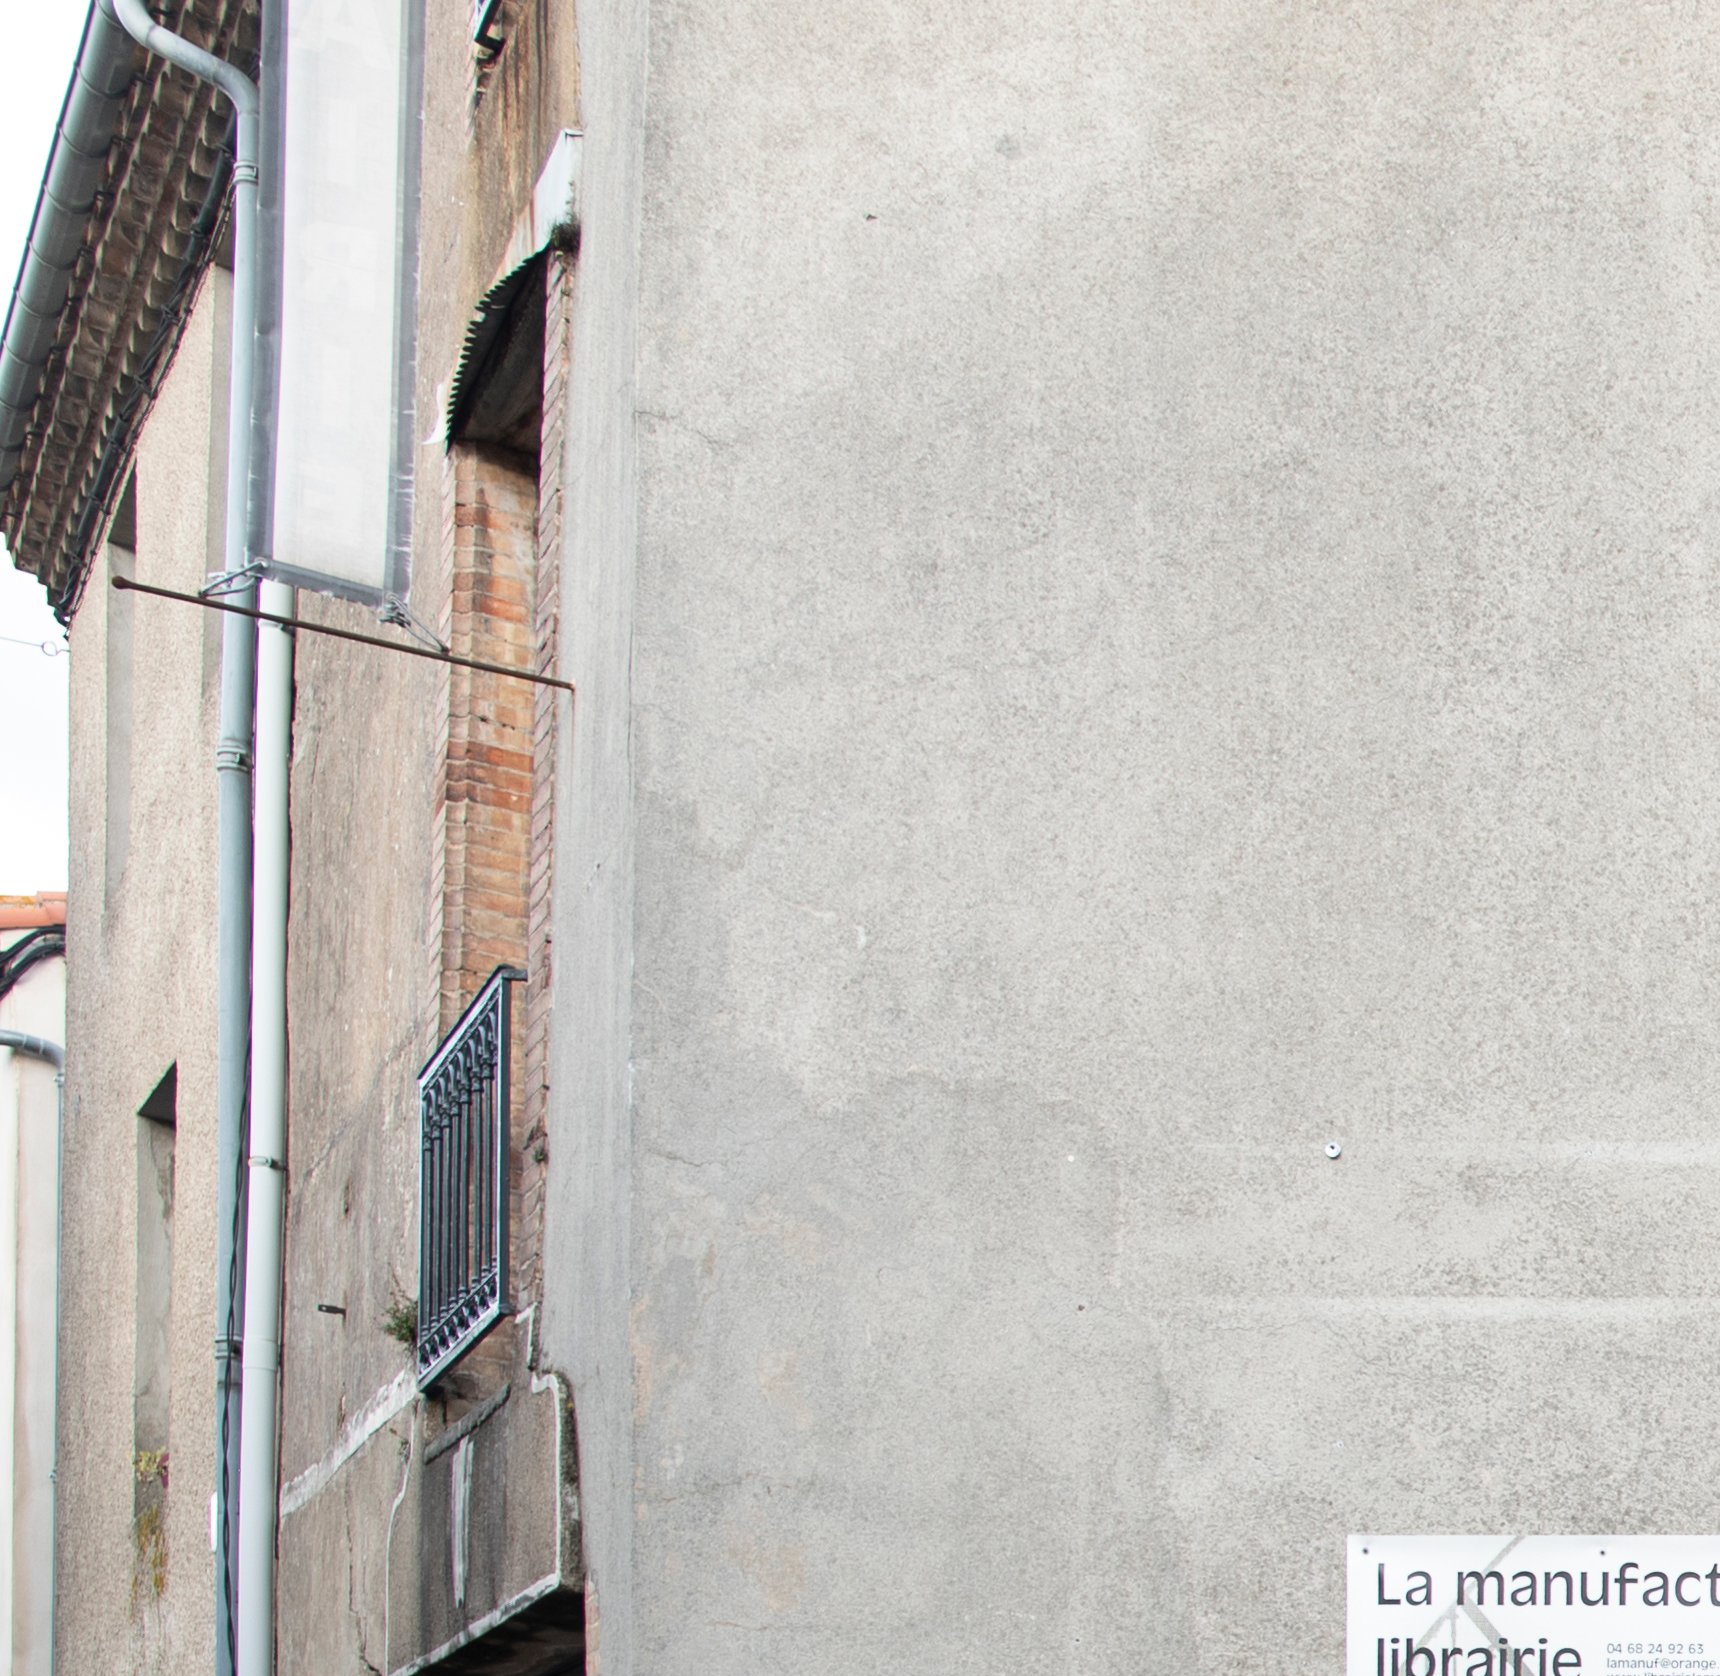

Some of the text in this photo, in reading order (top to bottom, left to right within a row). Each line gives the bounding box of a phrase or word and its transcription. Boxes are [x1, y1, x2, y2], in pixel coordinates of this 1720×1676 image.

[1376, 1562, 1433, 1607] La
[1606, 1643, 1704, 1655] 04 68 24 92 63
